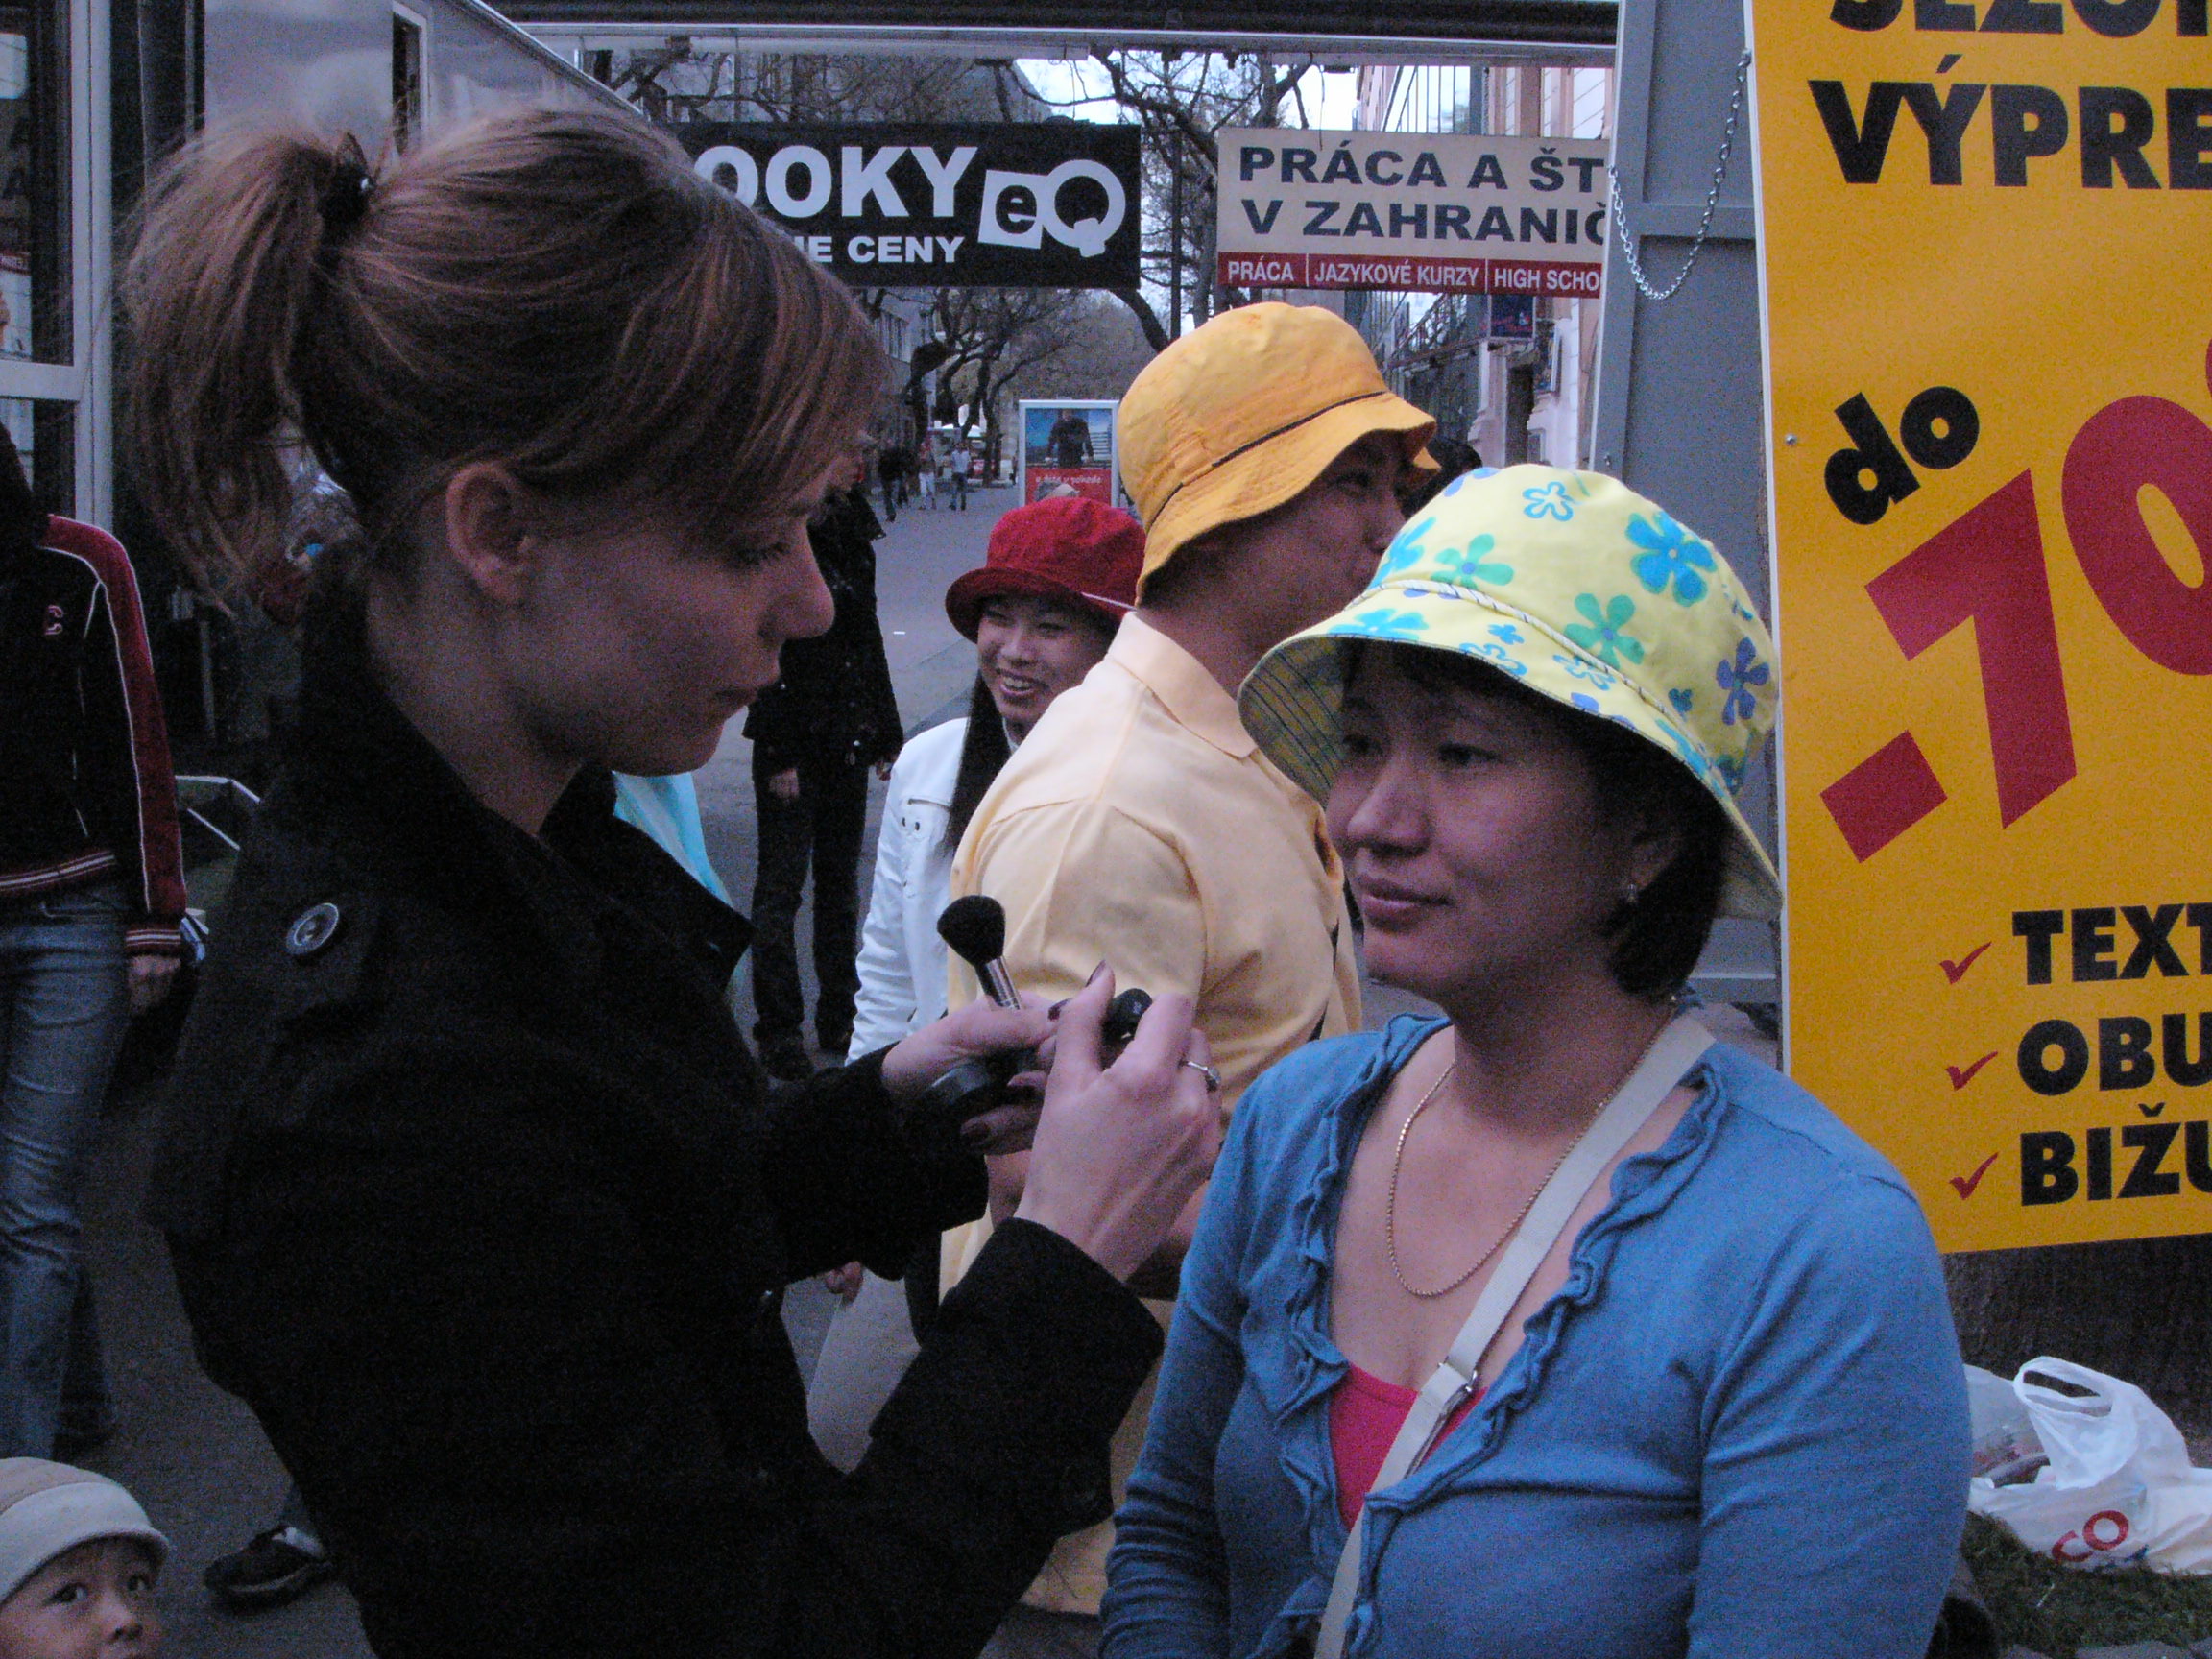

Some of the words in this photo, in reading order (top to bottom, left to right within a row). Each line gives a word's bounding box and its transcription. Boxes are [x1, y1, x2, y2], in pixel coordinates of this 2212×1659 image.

[1807, 54, 2212, 190] VÝPRE
[1240, 140, 1447, 188] PRÁCA
[1467, 154, 1508, 190] A
[1529, 147, 1604, 193] ŠT
[1241, 199, 1283, 235] V
[847, 236, 965, 264] CENY
[1228, 255, 1294, 282] PRÁCA
[1315, 259, 1411, 285] JAZYKOVÉ
[1417, 265, 1479, 286] KURZY
[1494, 268, 1540, 289] HIGH
[1546, 269, 1600, 291] SCHO
[1824, 386, 1979, 525] do
[2017, 1012, 2212, 1096] OBU
